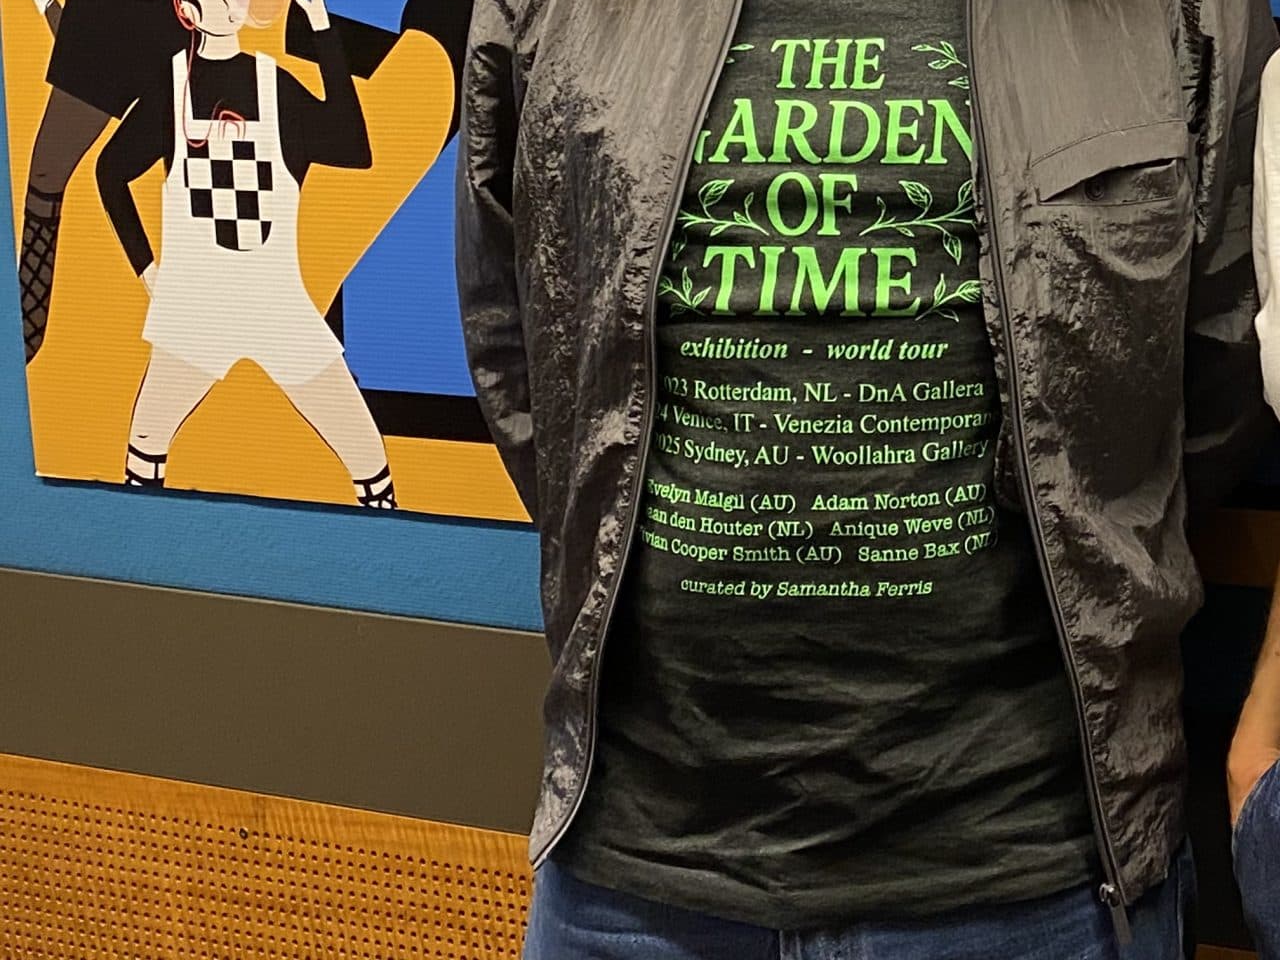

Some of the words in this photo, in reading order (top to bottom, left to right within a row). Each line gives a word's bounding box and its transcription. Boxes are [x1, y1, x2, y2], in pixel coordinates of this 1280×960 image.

[771, 35, 886, 92] THE
[693, 97, 975, 166] ARDEN
[765, 170, 859, 239] OF
[702, 245, 923, 317] TIME
[680, 337, 788, 360] exhibition
[827, 338, 893, 361] world
[898, 341, 948, 360] tour
[694, 380, 797, 404] Rotterdam,
[804, 383, 838, 403] NL
[859, 384, 907, 403] DnA
[913, 380, 984, 402] Gallera
[673, 405, 728, 433] Venice,
[734, 413, 755, 432] IT
[774, 413, 853, 434] Venezia
[684, 439, 750, 468] Sydney,
[754, 445, 789, 466] AU
[811, 444, 915, 466] Woollahra
[922, 440, 989, 463] Gallery
[750, 494, 796, 514] (AU)
[811, 494, 869, 511] Adam
[874, 491, 939, 510] Norton
[945, 483, 986, 507] (AU)
[670, 512, 696, 531] den
[699, 517, 763, 536] Houter
[768, 520, 813, 540] (NL)
[829, 521, 899, 540] Anique
[903, 517, 953, 535] Weve
[958, 506, 995, 531] (NL)
[671, 539, 728, 562] Cooper
[732, 546, 792, 562] Smith
[797, 545, 842, 565] (AU)
[858, 545, 918, 562] Sanne
[925, 542, 960, 559] Bax
[680, 580, 746, 596] curated
[750, 580, 773, 598] by
[777, 579, 871, 597] Samantha
[876, 579, 933, 596] Ferris
